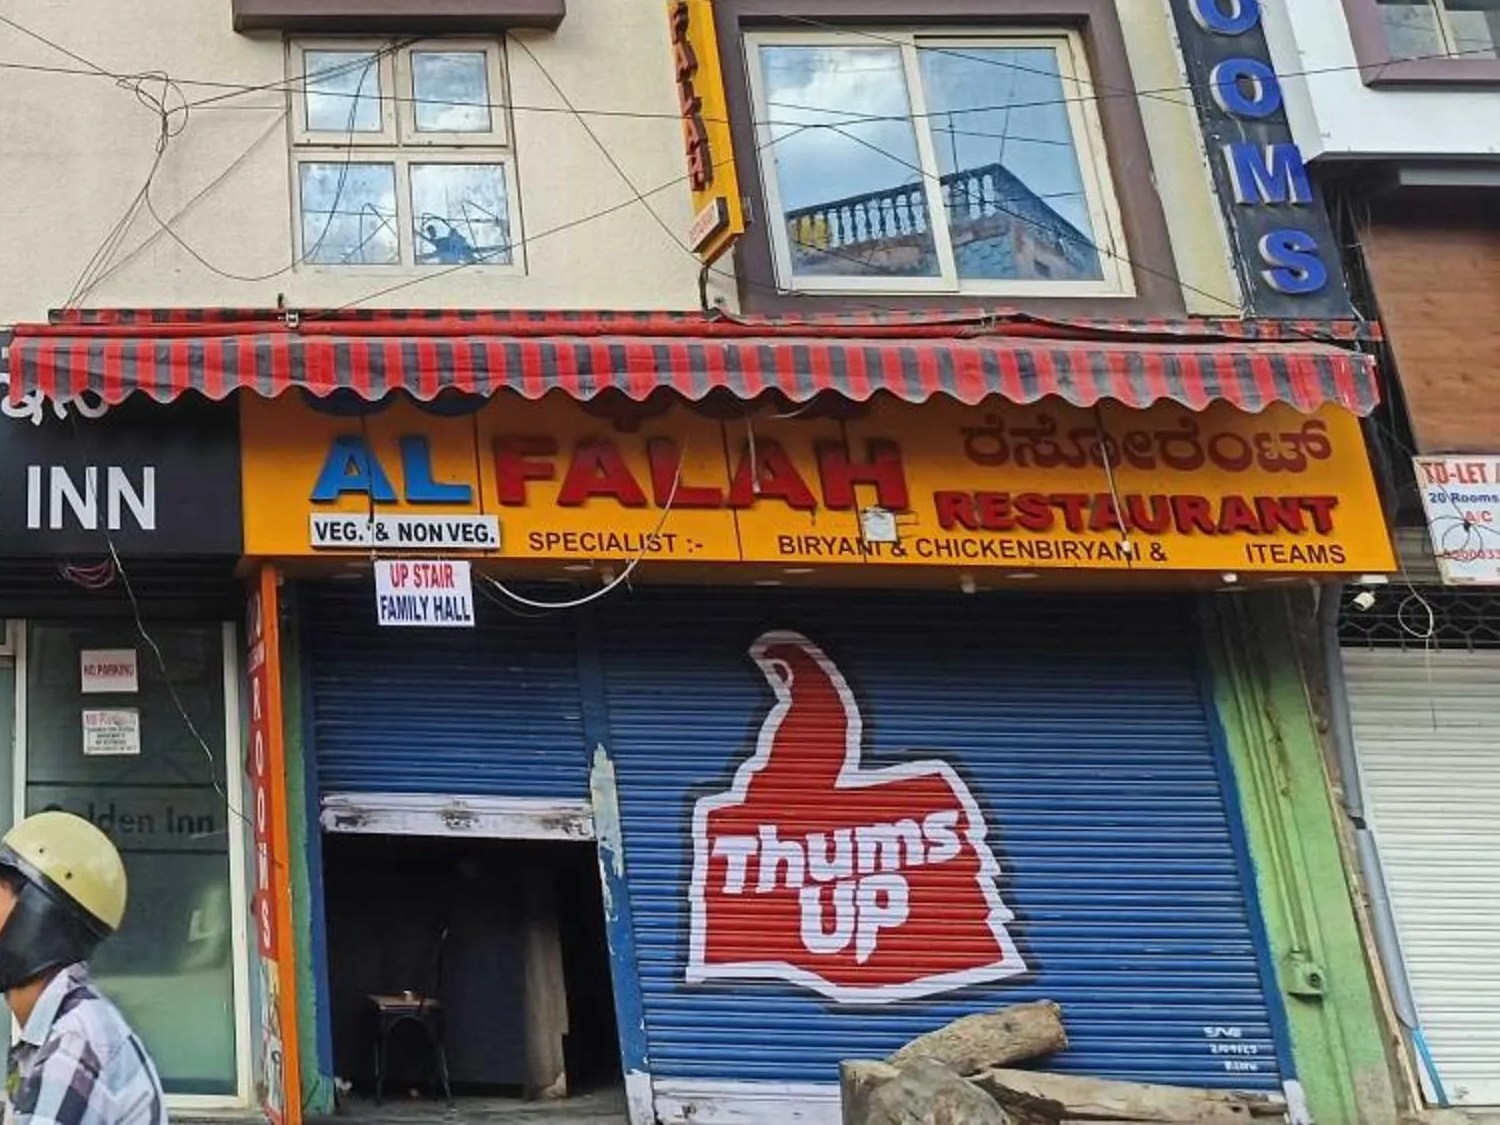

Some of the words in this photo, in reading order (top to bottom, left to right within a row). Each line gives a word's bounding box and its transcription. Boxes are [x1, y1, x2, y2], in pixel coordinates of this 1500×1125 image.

[309, 432, 474, 504] AL
[491, 434, 911, 511] FALAH
[26, 464, 157, 531] INN
[934, 490, 1340, 536] RESTAURANT
[314, 521, 364, 542] VEG.
[399, 523, 443, 542] NON
[446, 523, 495, 543] VEG.
[529, 531, 677, 555] SPECIALIST
[1150, 541, 1167, 562] &
[1245, 541, 1347, 564] ITEAMS
[390, 563, 409, 588] UP
[413, 563, 455, 589] STAIR
[380, 595, 430, 621] FAMILY
[433, 596, 471, 622] HALL
[711, 809, 964, 895] Thums
